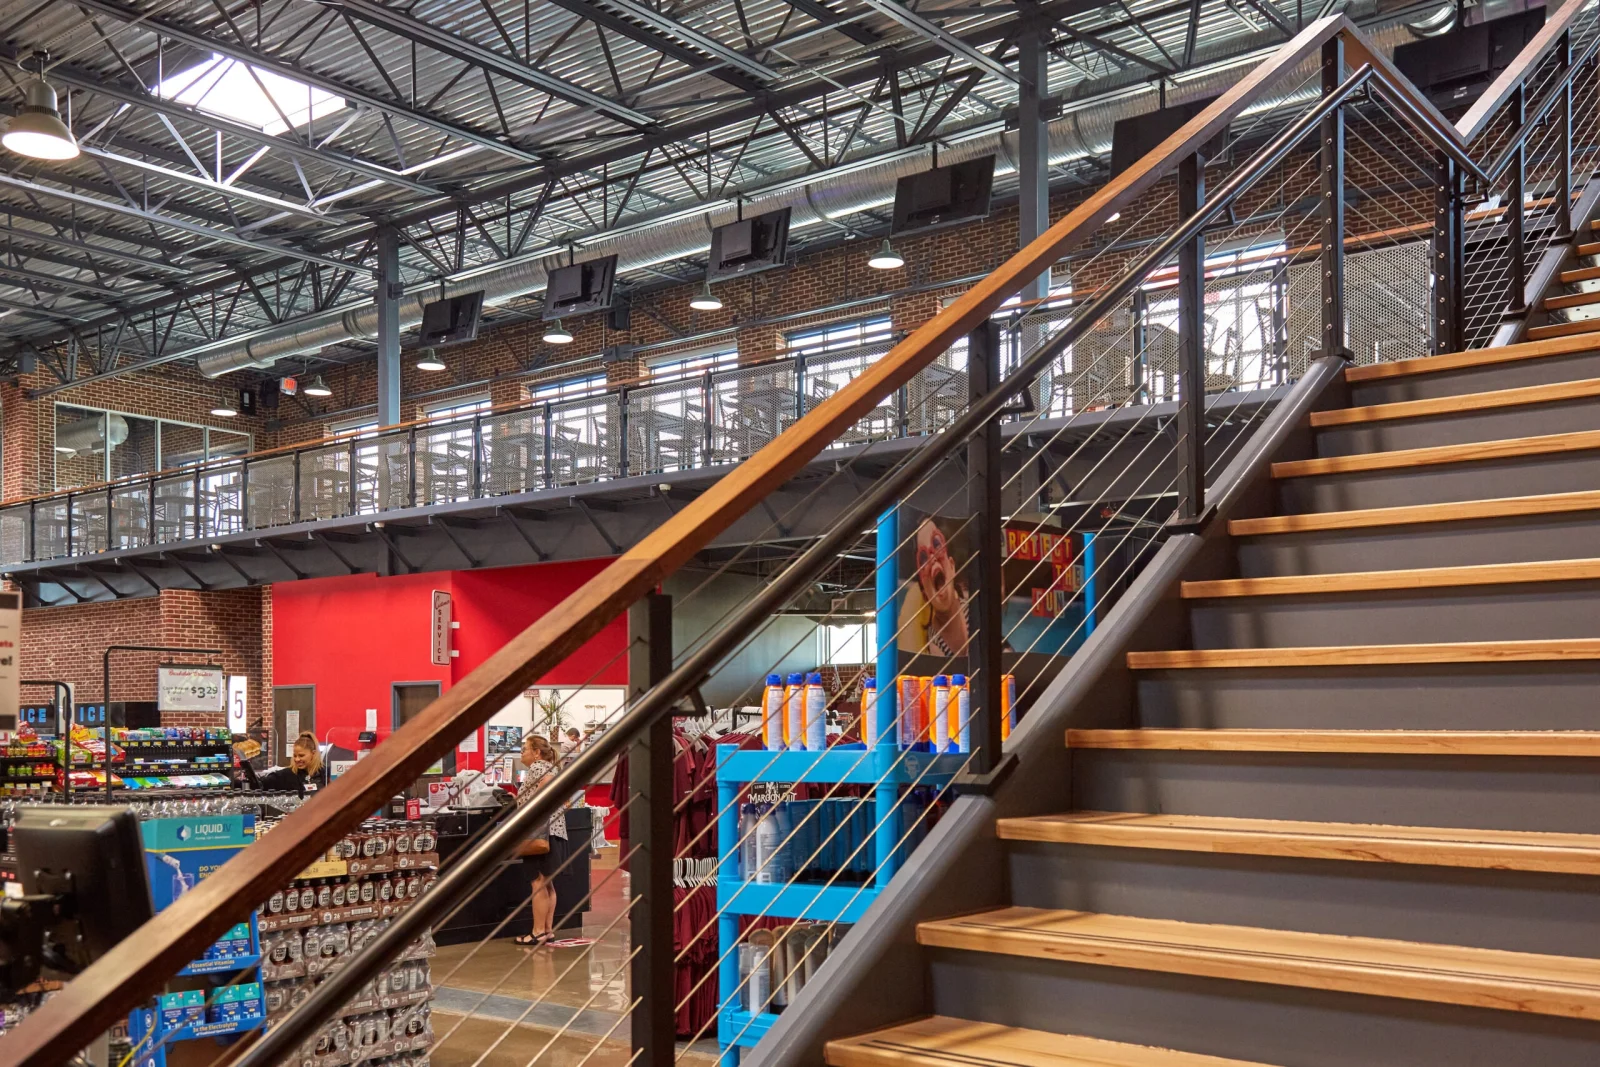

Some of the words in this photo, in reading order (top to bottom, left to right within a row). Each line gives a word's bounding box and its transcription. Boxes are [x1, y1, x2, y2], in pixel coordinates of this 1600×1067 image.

[1056, 564, 1081, 591] THE
[1036, 590, 1064, 615] FUN
[234, 690, 243, 719] 5
[20, 708, 46, 722] ICE
[80, 706, 104, 722] ICE
[748, 792, 780, 804] MAROON
[194, 824, 223, 834] LIQUID
